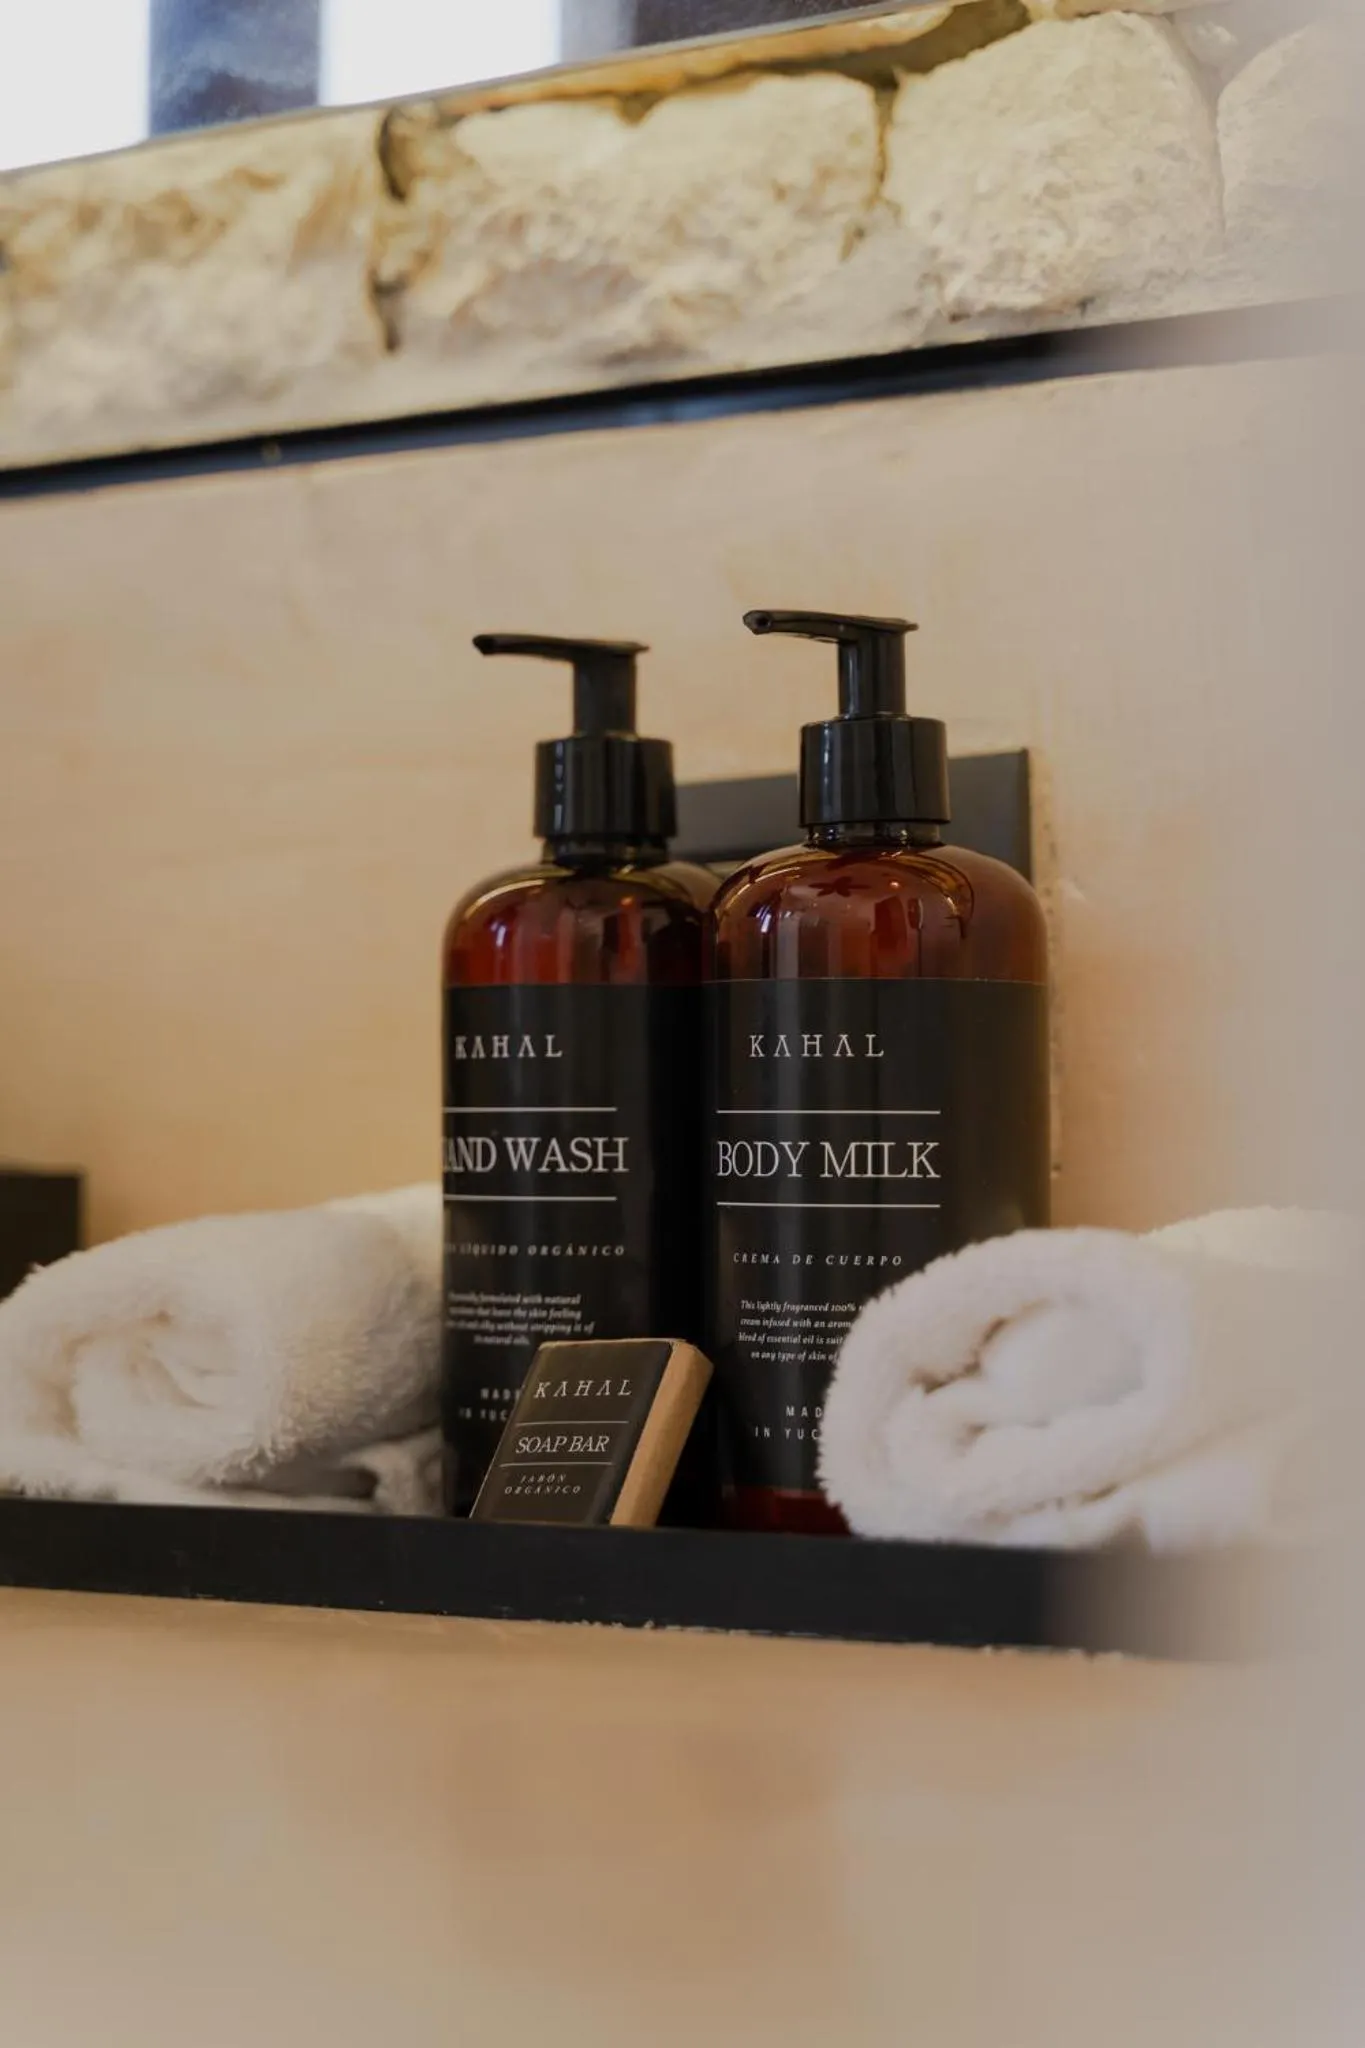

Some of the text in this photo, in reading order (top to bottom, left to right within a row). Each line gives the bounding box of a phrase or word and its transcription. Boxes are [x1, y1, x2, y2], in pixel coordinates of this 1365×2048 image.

[455, 1034, 563, 1060] KAHAL
[749, 1034, 884, 1057] KAHAL
[502, 1137, 630, 1173] WASH
[717, 1140, 941, 1178] BODY MILK
[528, 1243, 625, 1256] ORGÁNICO
[733, 1252, 902, 1266] CREMA DE CUERPO
[549, 1308, 582, 1320] feeling
[740, 1300, 755, 1310] This
[756, 1301, 780, 1312] lightly
[782, 1301, 830, 1314] fragranced
[831, 1303, 856, 1312] 100%
[762, 1318, 791, 1328] infused
[792, 1318, 812, 1328] with
[813, 1320, 826, 1328] an
[827, 1320, 852, 1328] arom
[757, 1333, 766, 1344] of
[767, 1334, 801, 1344] essential
[802, 1334, 815, 1344] oil
[825, 1335, 843, 1344] suit
[777, 1352, 795, 1361] type
[796, 1351, 806, 1361] of
[808, 1351, 827, 1361] skin
[534, 1379, 632, 1399] KAHAL
[481, 1408, 509, 1422] YUC
[785, 1405, 822, 1418] MAD
[755, 1426, 820, 1440] IN YUC
[515, 1436, 609, 1454] SOAP BAR
